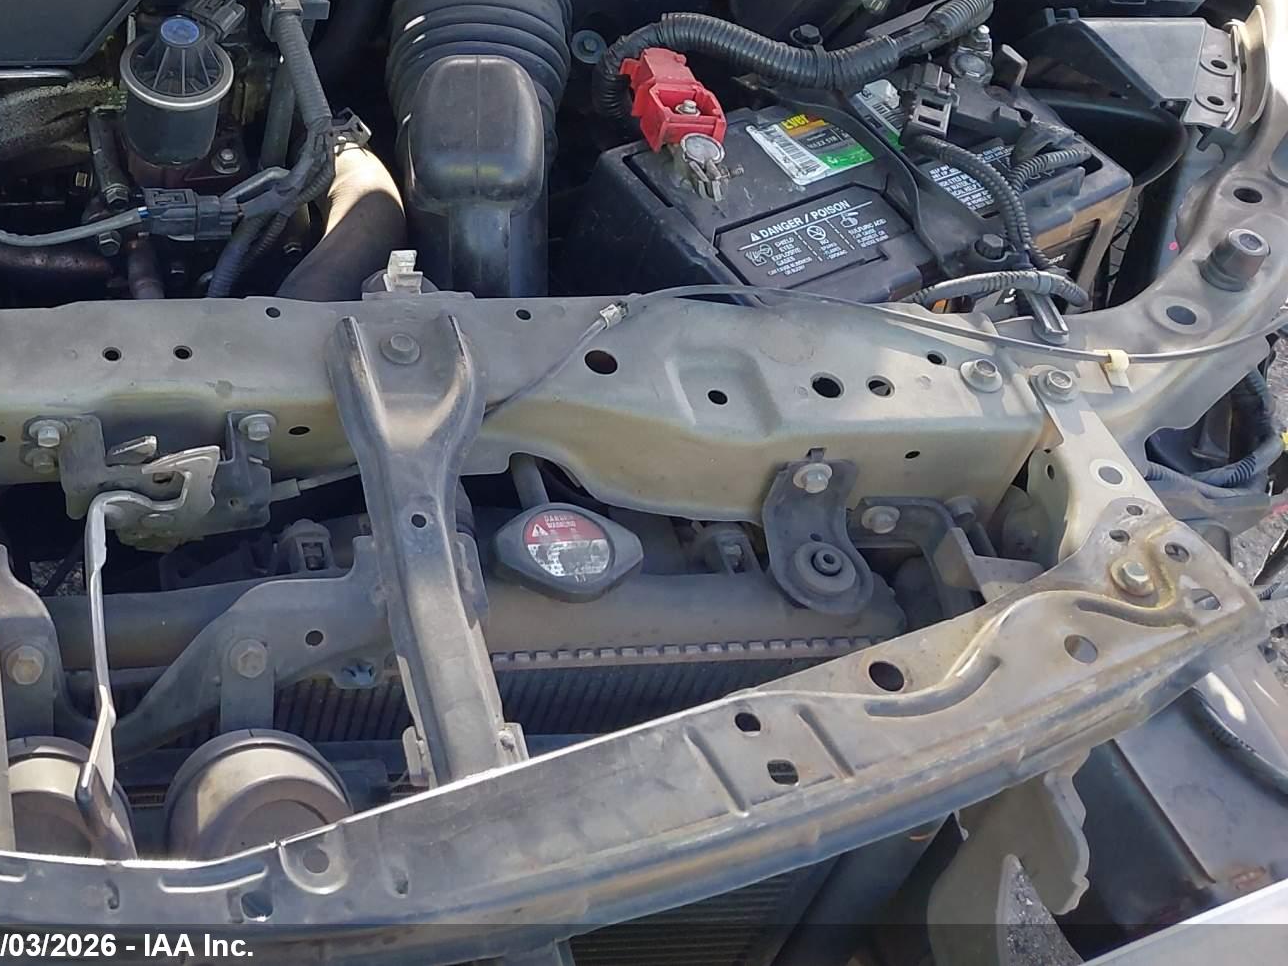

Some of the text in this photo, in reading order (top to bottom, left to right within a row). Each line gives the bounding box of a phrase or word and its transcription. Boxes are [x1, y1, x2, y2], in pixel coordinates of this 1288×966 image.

[759, 200, 851, 239] DANGER / POISON
